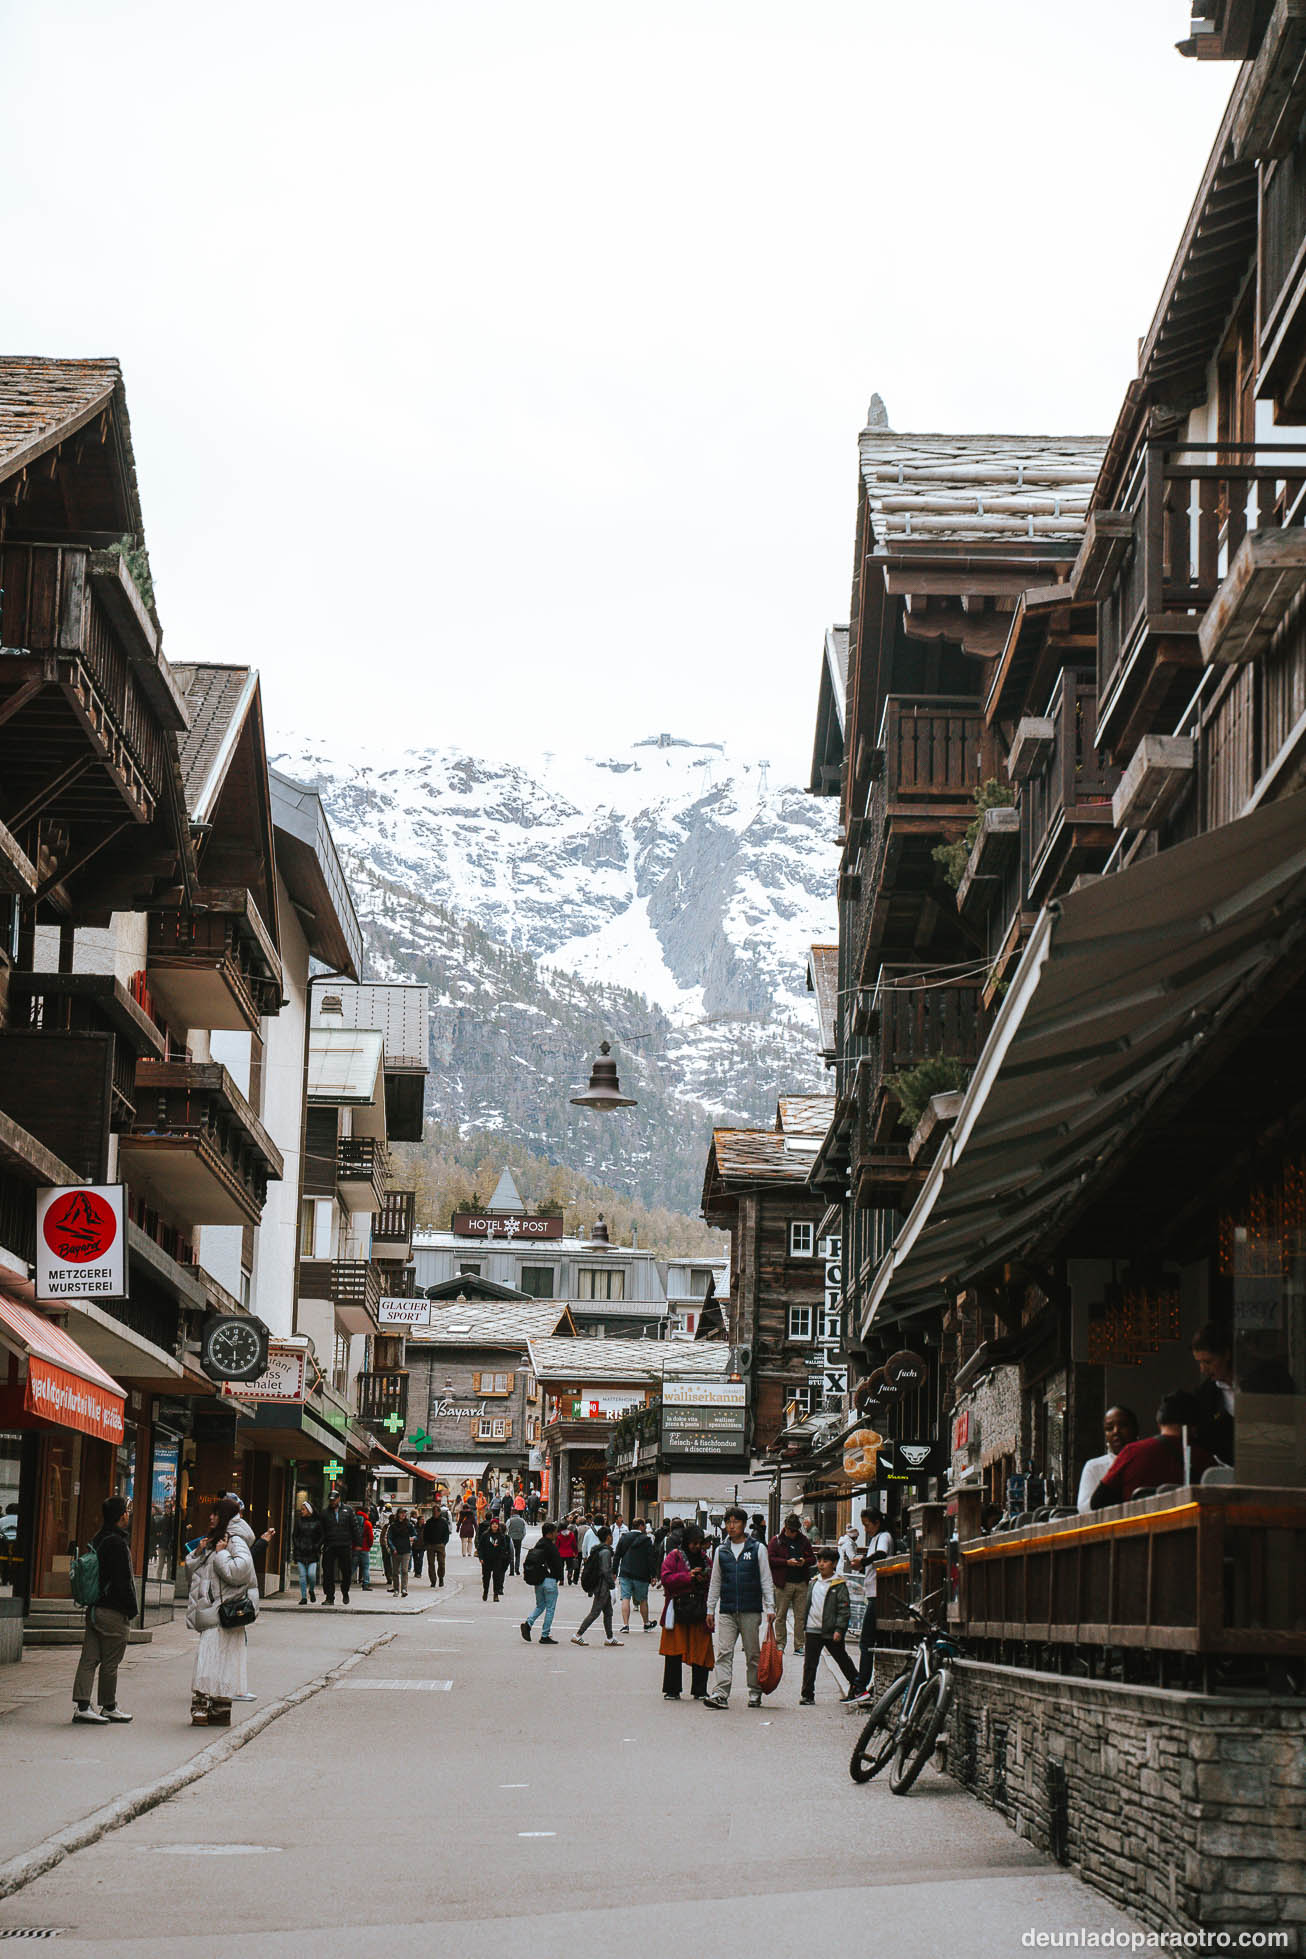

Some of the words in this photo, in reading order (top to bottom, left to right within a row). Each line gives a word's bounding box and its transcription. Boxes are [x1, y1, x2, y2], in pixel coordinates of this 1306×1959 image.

[469, 1219, 502, 1231] HOTEL
[522, 1221, 549, 1232] POST
[48, 1269, 112, 1279] METZGEREI
[48, 1282, 113, 1292] WURSTEREI
[382, 1301, 428, 1311] GLACIER
[387, 1311, 422, 1321] SPORT
[896, 1369, 917, 1380] fuchs
[245, 1380, 283, 1389] Chalet
[664, 1391, 745, 1403] walliserkanne
[433, 1400, 487, 1423] Bayard
[700, 1439, 737, 1447] fischfondue
